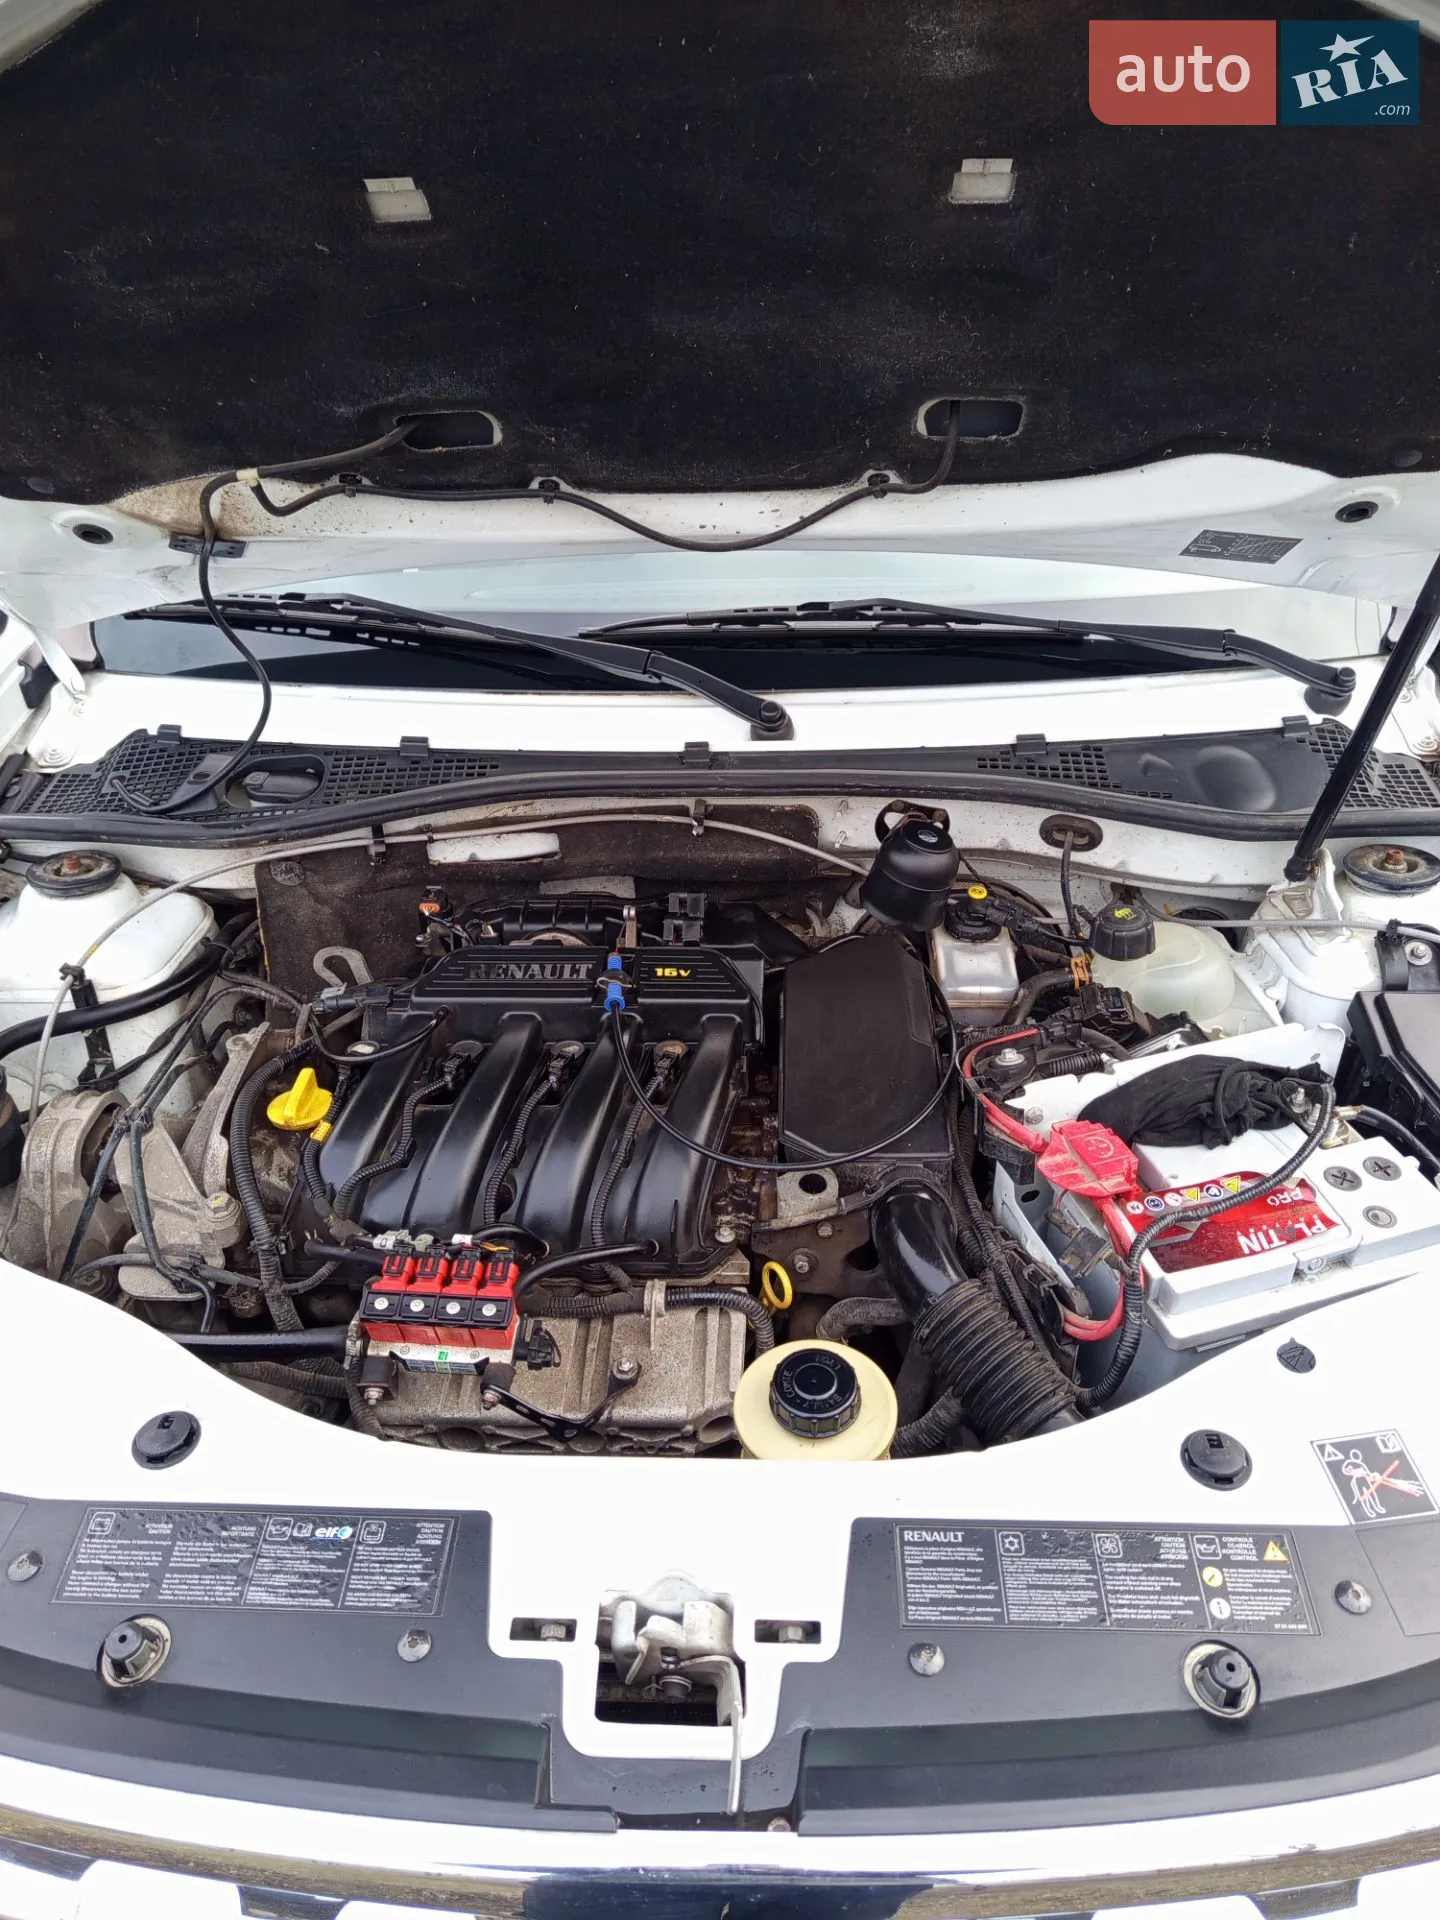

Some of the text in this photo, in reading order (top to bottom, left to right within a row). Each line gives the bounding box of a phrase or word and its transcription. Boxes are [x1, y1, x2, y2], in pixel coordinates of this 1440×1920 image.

[469, 963, 593, 980] RENAULT
[654, 967, 691, 977] 16v
[1267, 1187, 1304, 1207] PRO
[314, 1526, 338, 1538] elf
[903, 1530, 965, 1543] RENAULT
